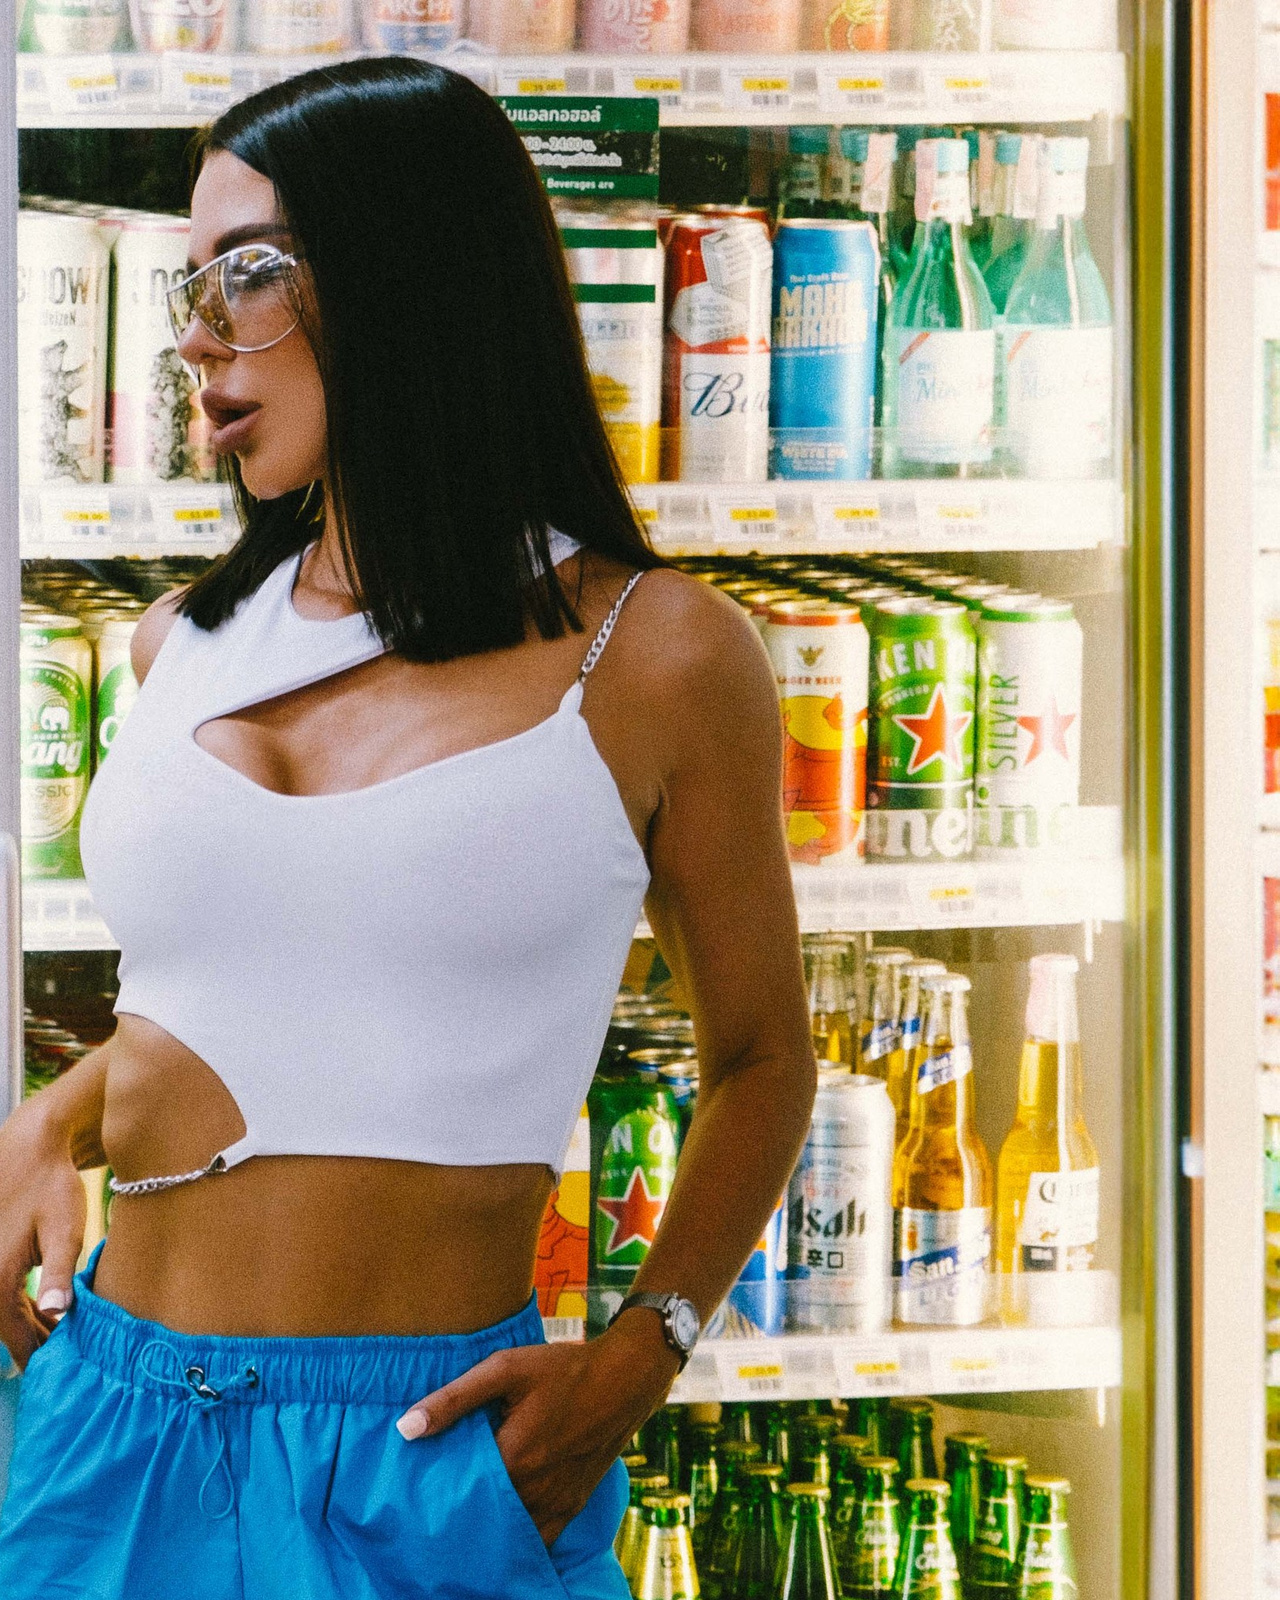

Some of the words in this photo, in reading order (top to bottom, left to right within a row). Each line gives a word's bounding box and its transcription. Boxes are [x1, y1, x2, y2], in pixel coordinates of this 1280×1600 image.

[547, 177, 596, 191] Beverages
[597, 181, 615, 190] are
[987, 673, 1020, 773] SILVER
